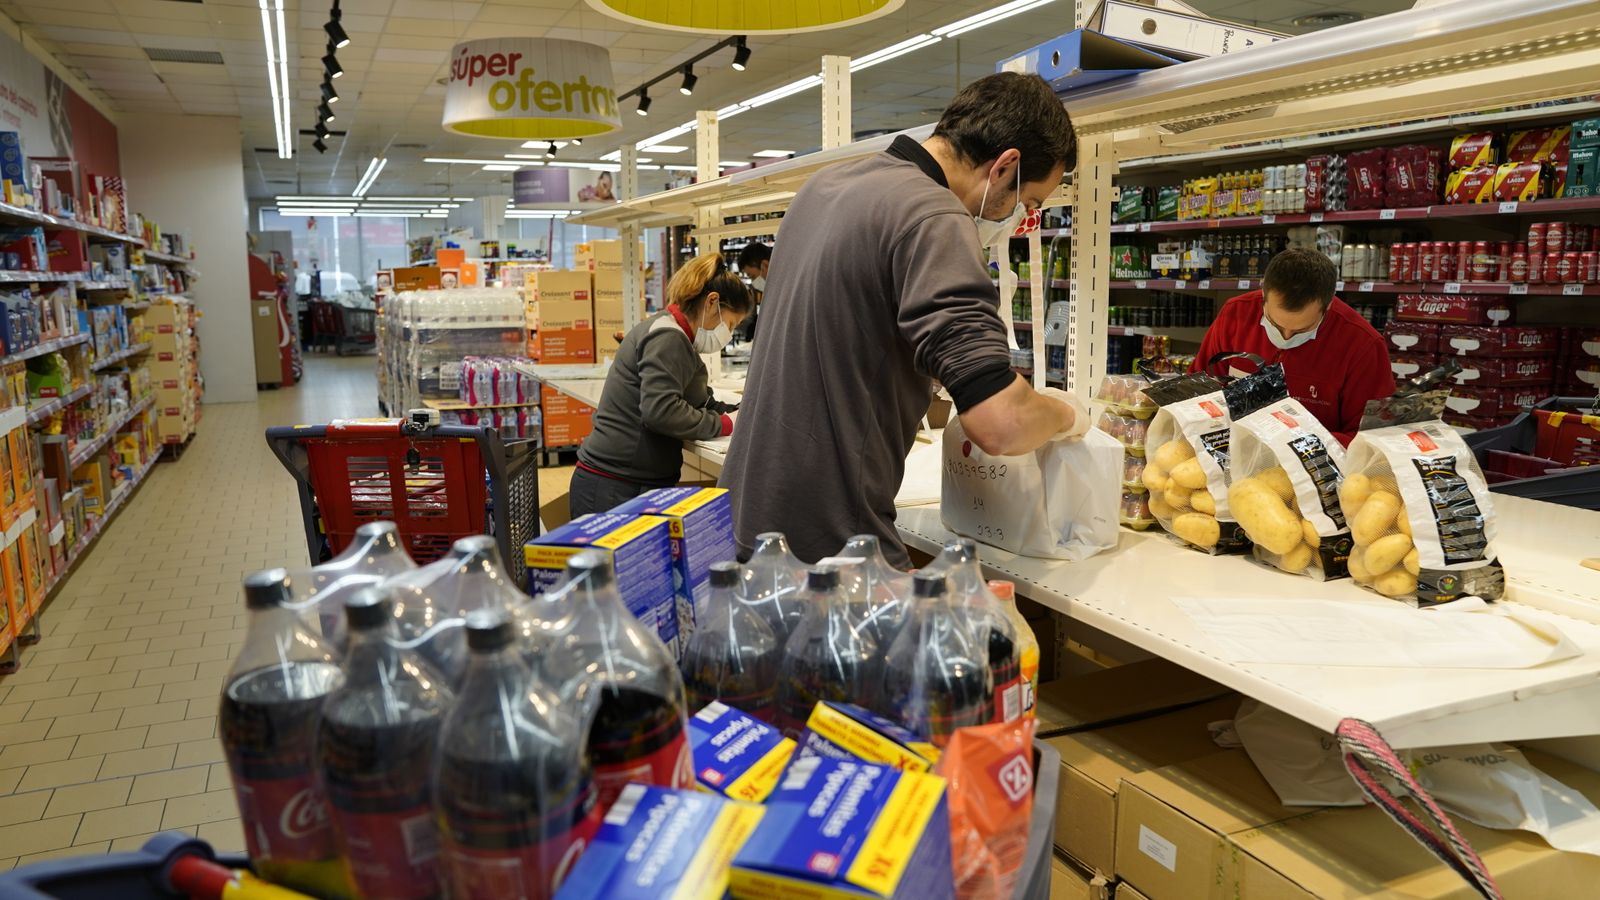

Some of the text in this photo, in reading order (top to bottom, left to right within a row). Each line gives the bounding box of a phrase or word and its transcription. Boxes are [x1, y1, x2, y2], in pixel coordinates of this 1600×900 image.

[450, 47, 522, 87] súper
[487, 67, 618, 117] ofertas
[1417, 299, 1450, 314] Lager
[542, 320, 572, 328] Croissant
[1518, 331, 1542, 346] Lager
[1516, 362, 1540, 376] Lager
[1513, 393, 1536, 408] Lager
[807, 761, 857, 818] Pipocas
[823, 764, 882, 838] Palomitas
[625, 793, 680, 862] Pipocas
